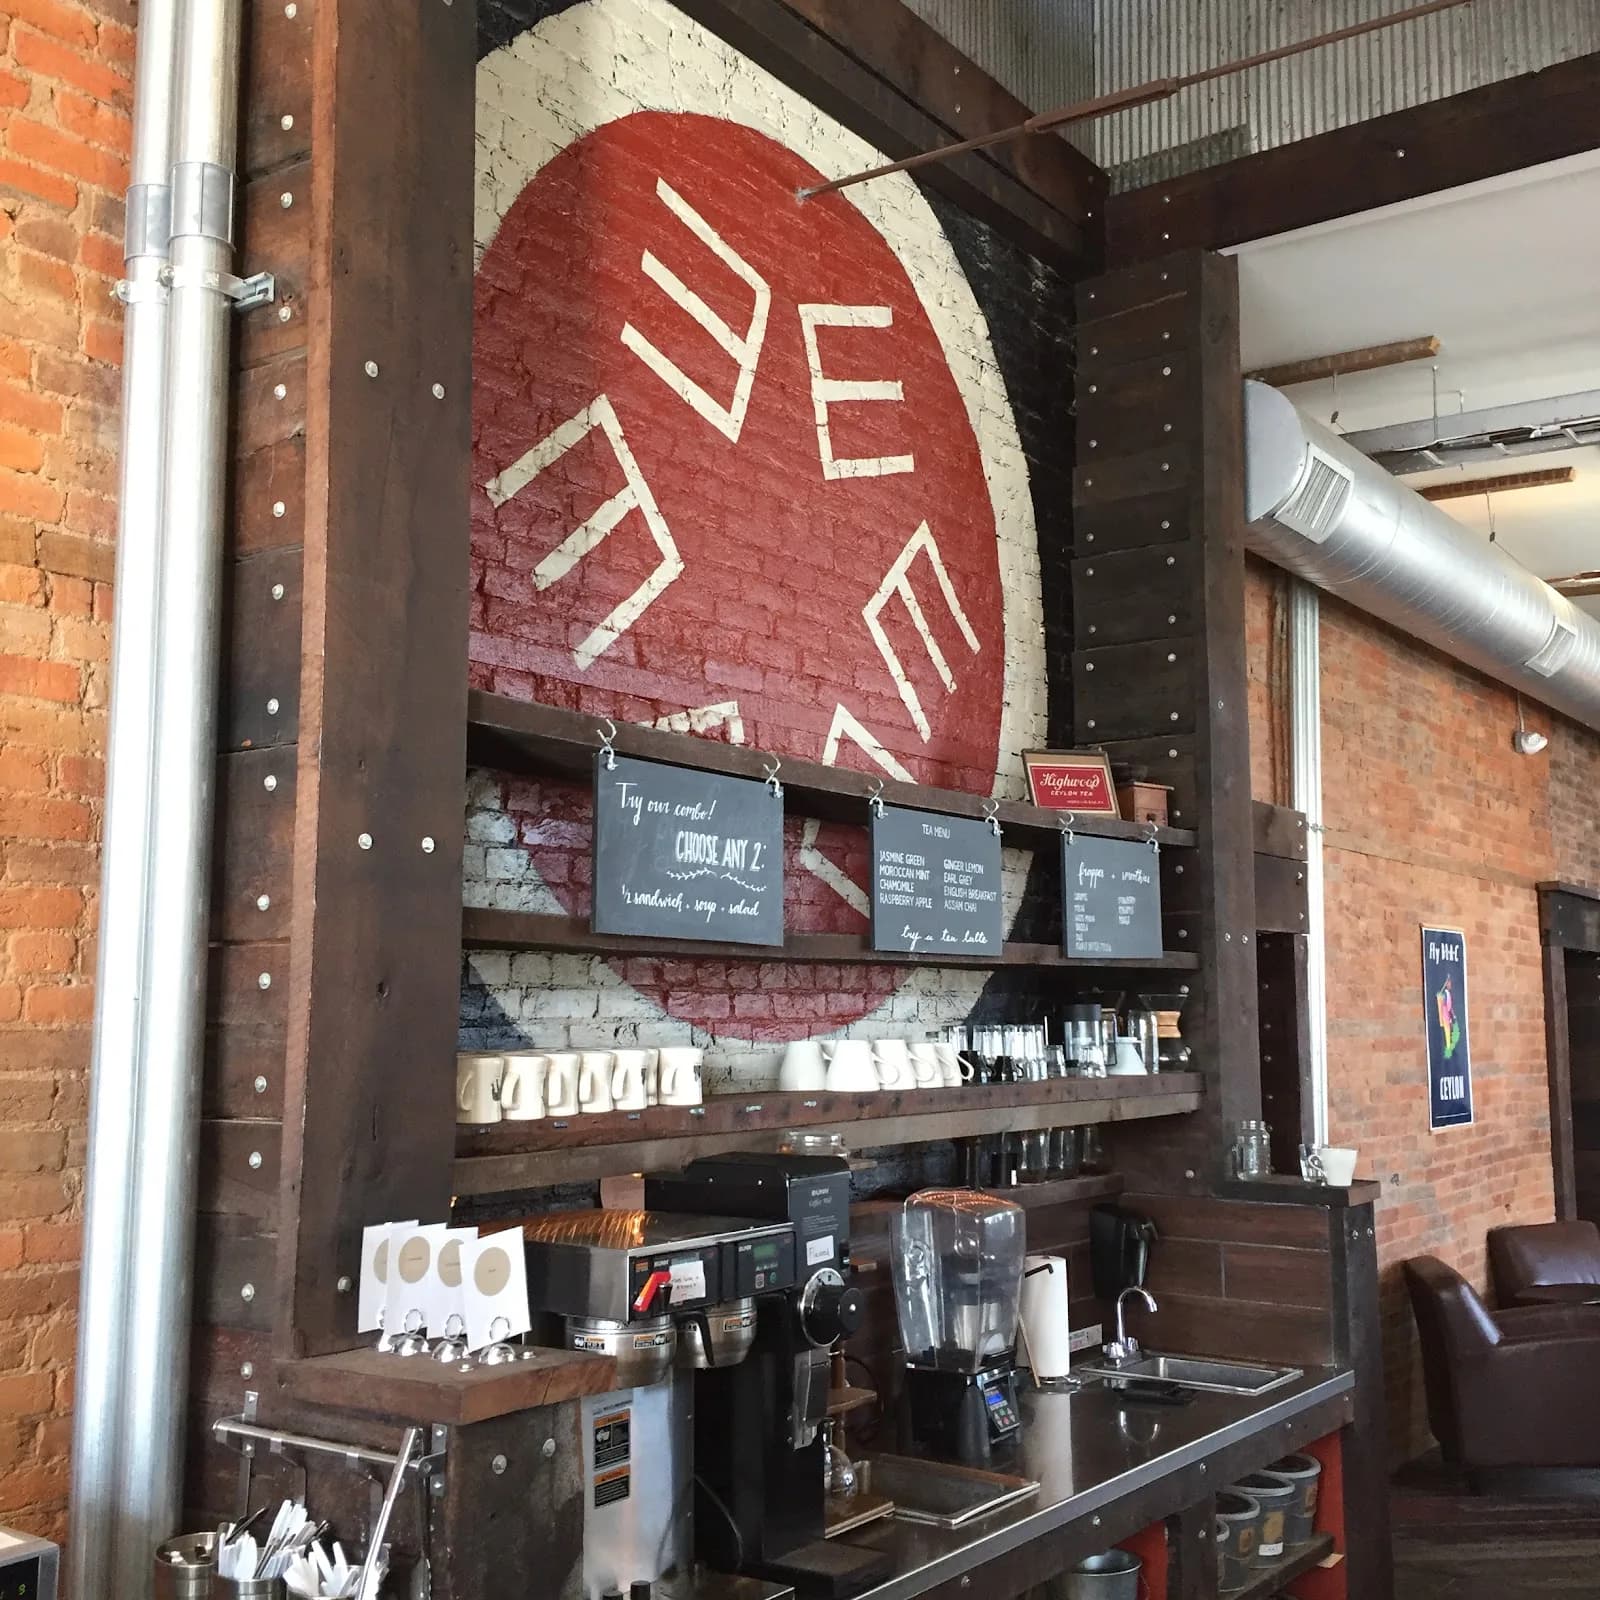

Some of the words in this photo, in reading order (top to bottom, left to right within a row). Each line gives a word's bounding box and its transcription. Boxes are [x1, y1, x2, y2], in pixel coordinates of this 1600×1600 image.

[1040, 773, 1100, 791] Highwood
[616, 782, 643, 825] Try
[647, 799, 671, 813] our
[673, 799, 717, 821] combo!
[922, 823, 934, 835] TEA
[934, 826, 951, 839] MENU
[675, 830, 719, 866] CHOOSE
[722, 838, 749, 870] ANY
[879, 850, 905, 864] JASMINE
[905, 853, 926, 867] GREEN
[879, 864, 915, 879] MOROCCAN
[915, 868, 931, 881] MINT
[943, 858, 965, 872] GINGER
[965, 861, 984, 875] LEMON
[879, 878, 915, 893] CHAMOMILE
[943, 871, 958, 884] EARL
[958, 874, 973, 886] GREY
[879, 892, 915, 907] RASPBERRY
[915, 896, 933, 909] APPLE
[943, 885, 968, 898] ENGLISH
[968, 888, 997, 902] BREAKFAST
[634, 889, 683, 912] sandwich
[694, 898, 717, 922] soup
[728, 901, 760, 916] salad
[964, 901, 978, 913] CHAI
[901, 924, 922, 951] try
[924, 933, 934, 942] a
[941, 928, 958, 943] tea
[961, 930, 989, 945] latte
[1439, 1075, 1465, 1101] CEYLON
